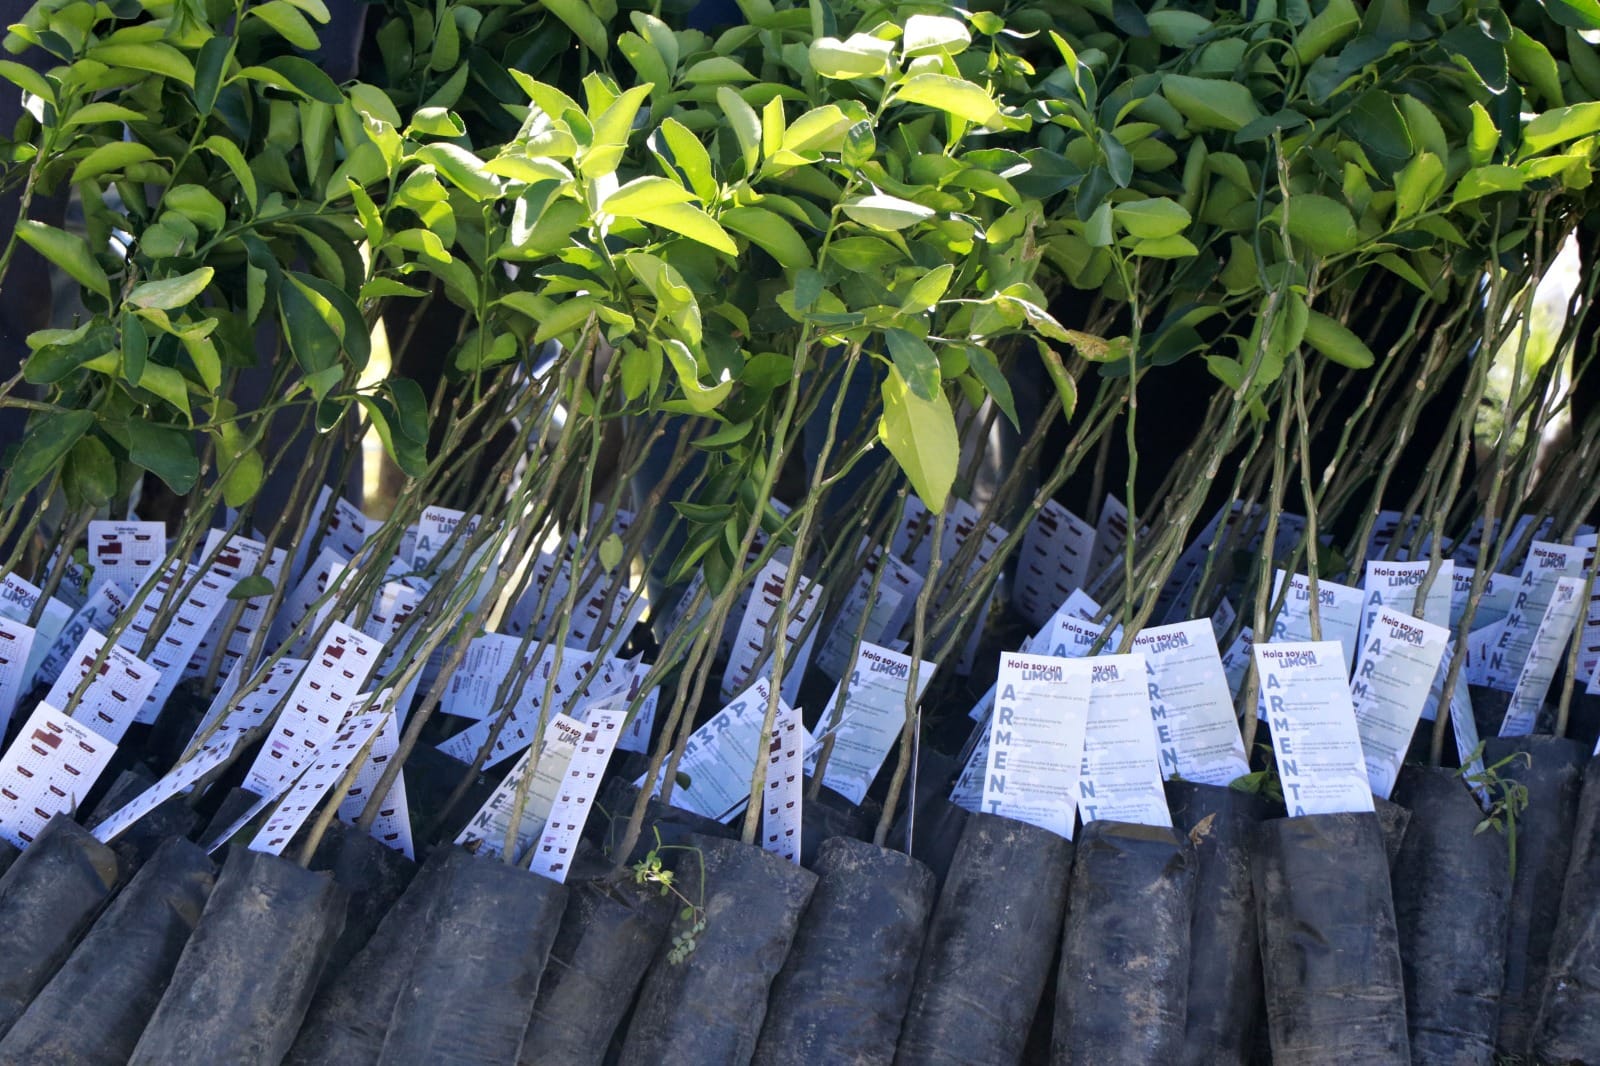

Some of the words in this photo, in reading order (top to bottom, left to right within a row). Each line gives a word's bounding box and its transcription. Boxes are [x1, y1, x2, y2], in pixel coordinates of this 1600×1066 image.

[1374, 568, 1395, 577] Hola
[1062, 620, 1083, 634] Hola
[1381, 613, 1399, 628] Hola
[1134, 635, 1156, 646] Hola
[862, 649, 882, 662] Hola
[1262, 649, 1284, 659] Hola
[1285, 650, 1301, 660] soy
[1008, 659, 1030, 670] Hola
[1031, 663, 1048, 672] soy
